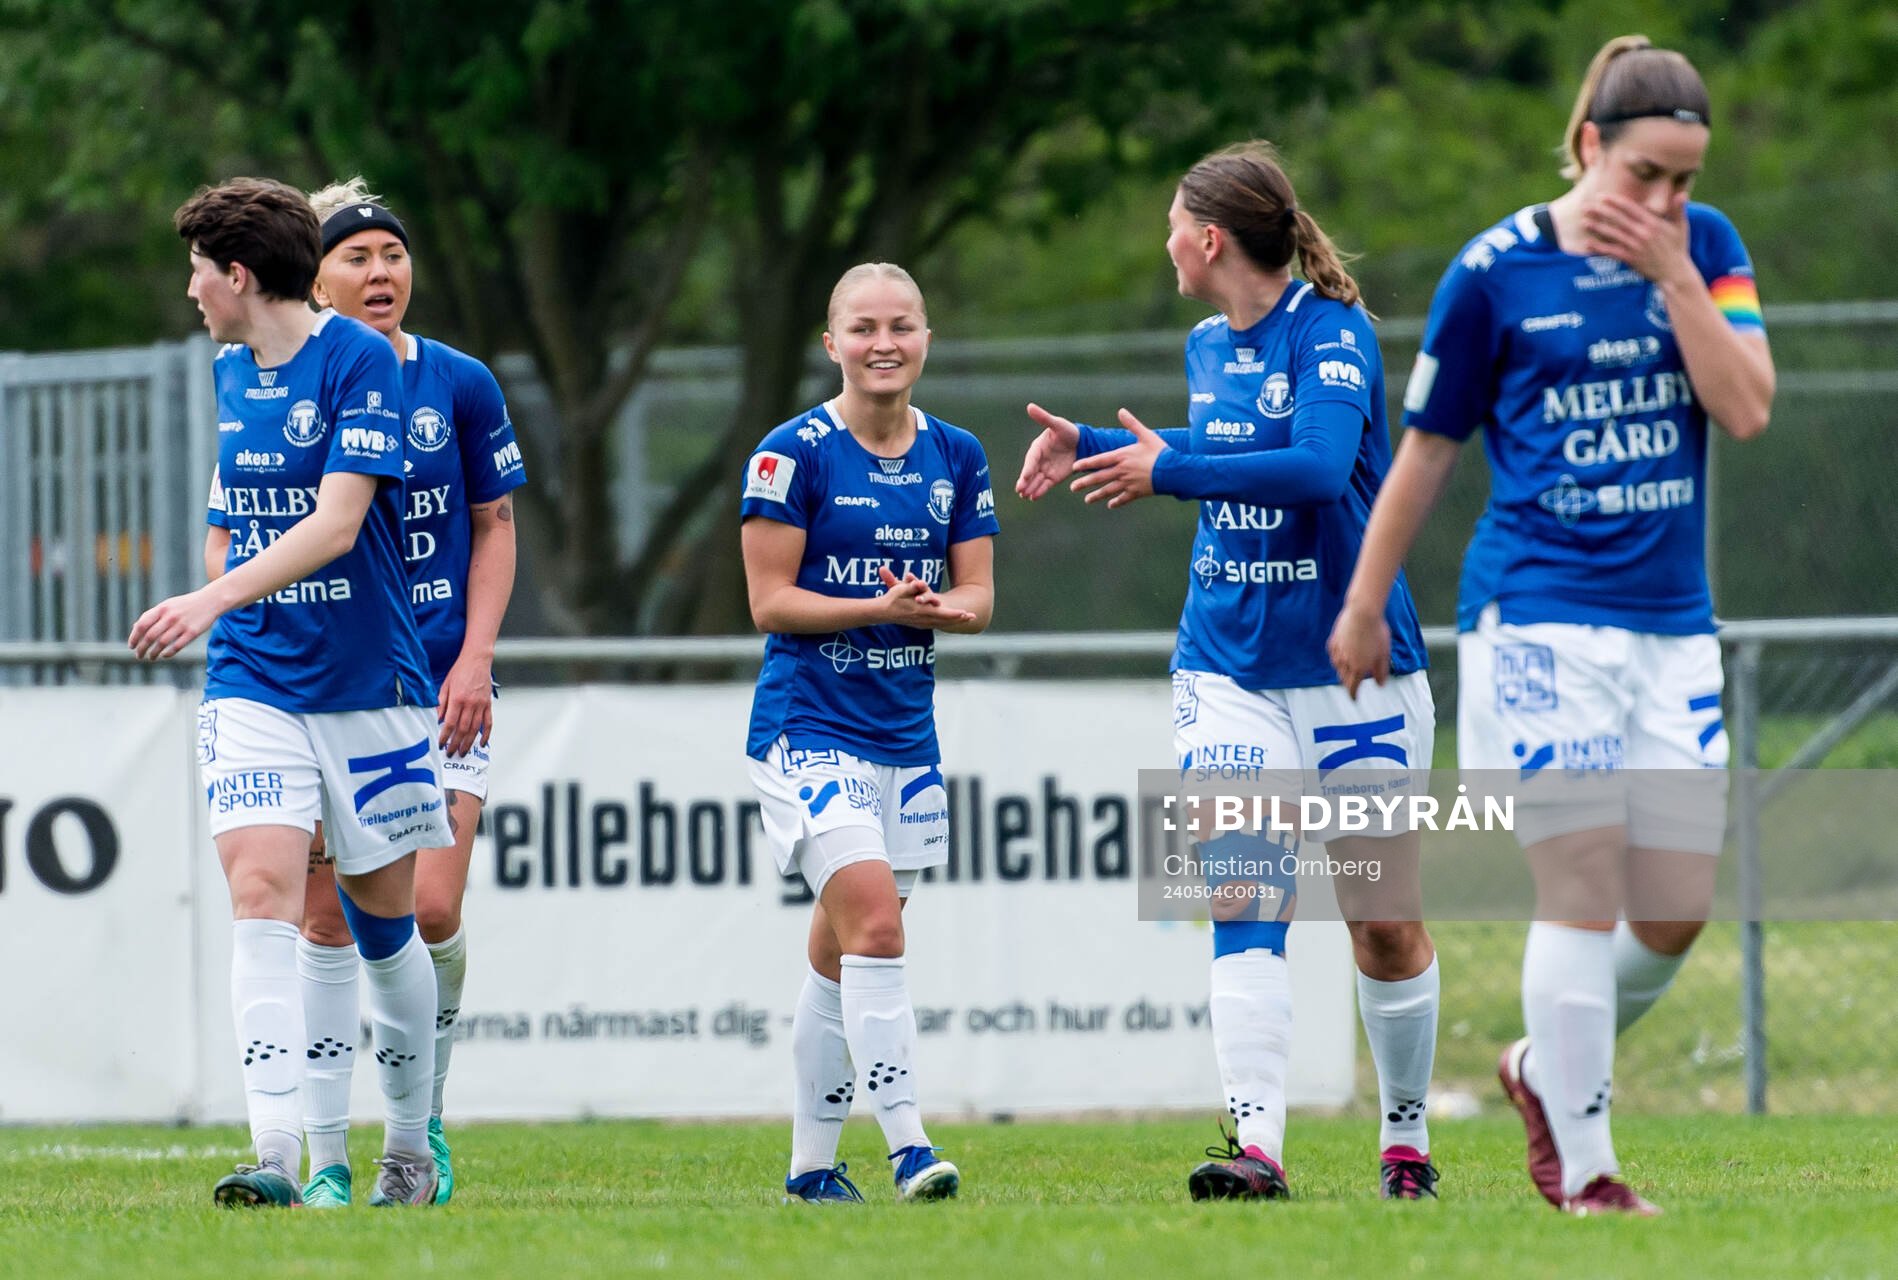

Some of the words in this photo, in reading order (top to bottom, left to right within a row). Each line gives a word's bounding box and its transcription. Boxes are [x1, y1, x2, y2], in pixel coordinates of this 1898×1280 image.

[1319, 360, 1361, 386] MVB
[1206, 418, 1241, 436] akea
[341, 428, 385, 452] MVB
[1562, 418, 1680, 467] GÅRD
[235, 449, 270, 466] akea
[834, 496, 871, 506] CRAFT
[875, 524, 914, 541] akea
[1197, 744, 1265, 764] INTER
[1196, 763, 1263, 782] SPORT
[216, 773, 283, 794] INTER
[219, 791, 282, 813] SPORT
[358, 804, 418, 828] Trelleborgs
[388, 824, 424, 842] CRAFT
[543, 1003, 699, 1039] närmast
[712, 1000, 769, 1048] dig
[967, 1001, 1035, 1032] och
[1050, 1000, 1112, 1032] hur
[1125, 999, 1173, 1032] du
